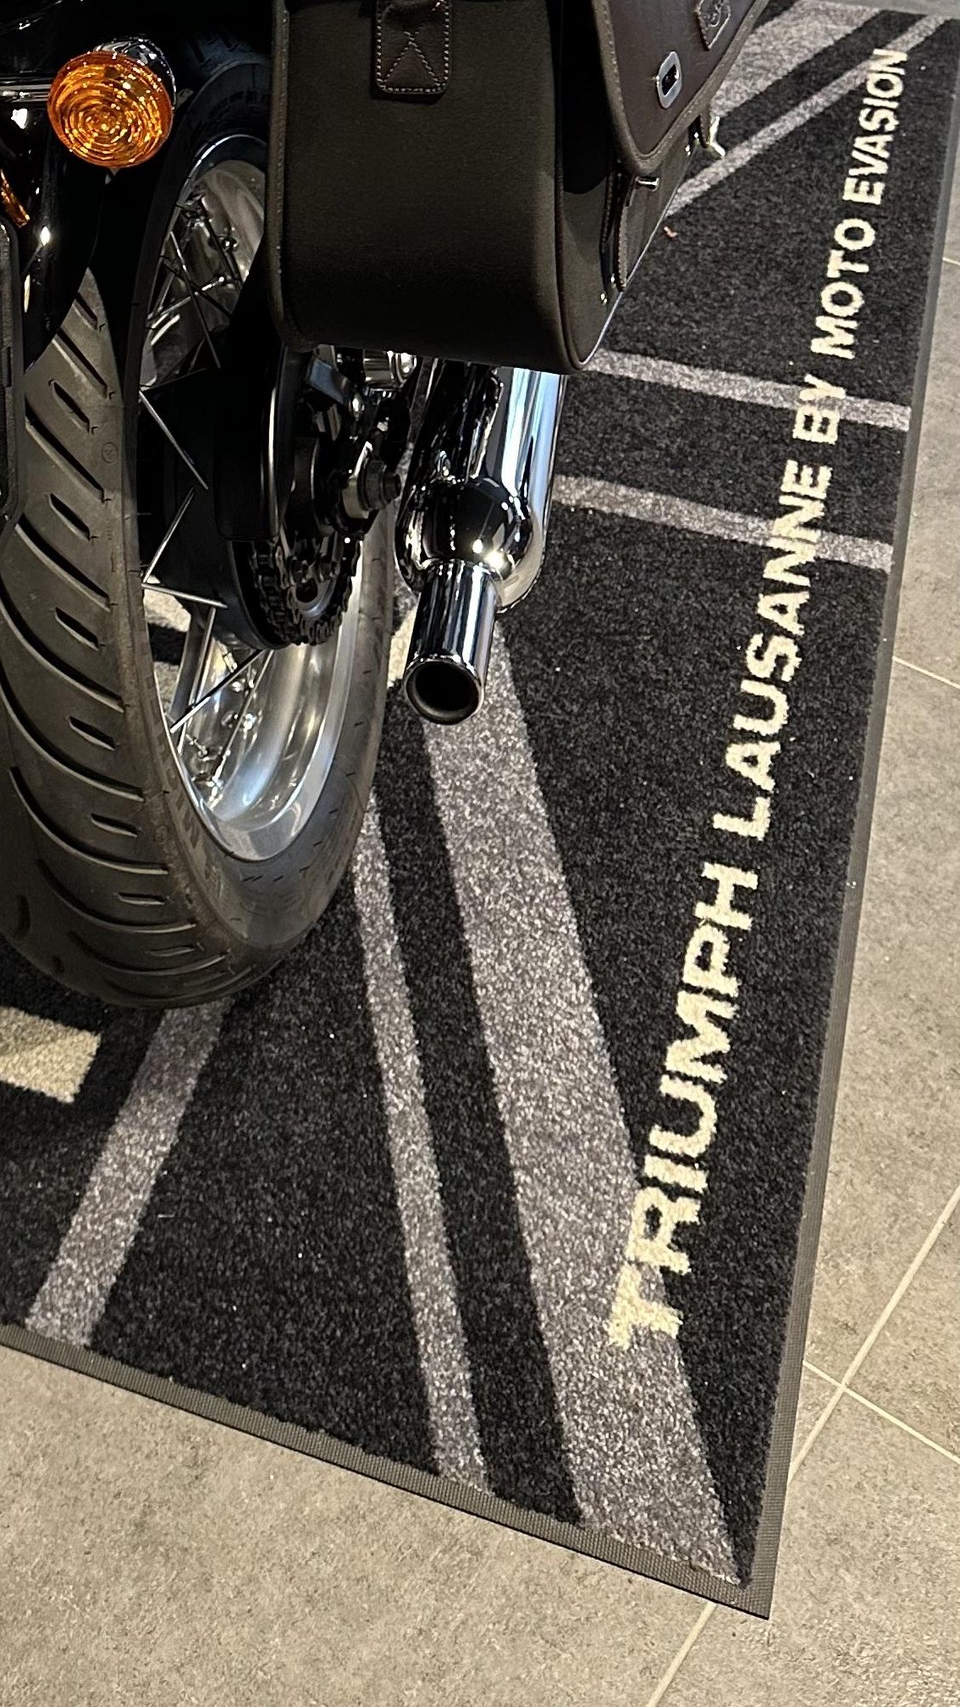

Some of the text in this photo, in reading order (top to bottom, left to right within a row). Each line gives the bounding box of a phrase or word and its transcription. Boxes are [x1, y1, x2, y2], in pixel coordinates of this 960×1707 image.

[607, 47, 909, 1350] TRIUMPH LAUSANNE BY MOTO EVASION
